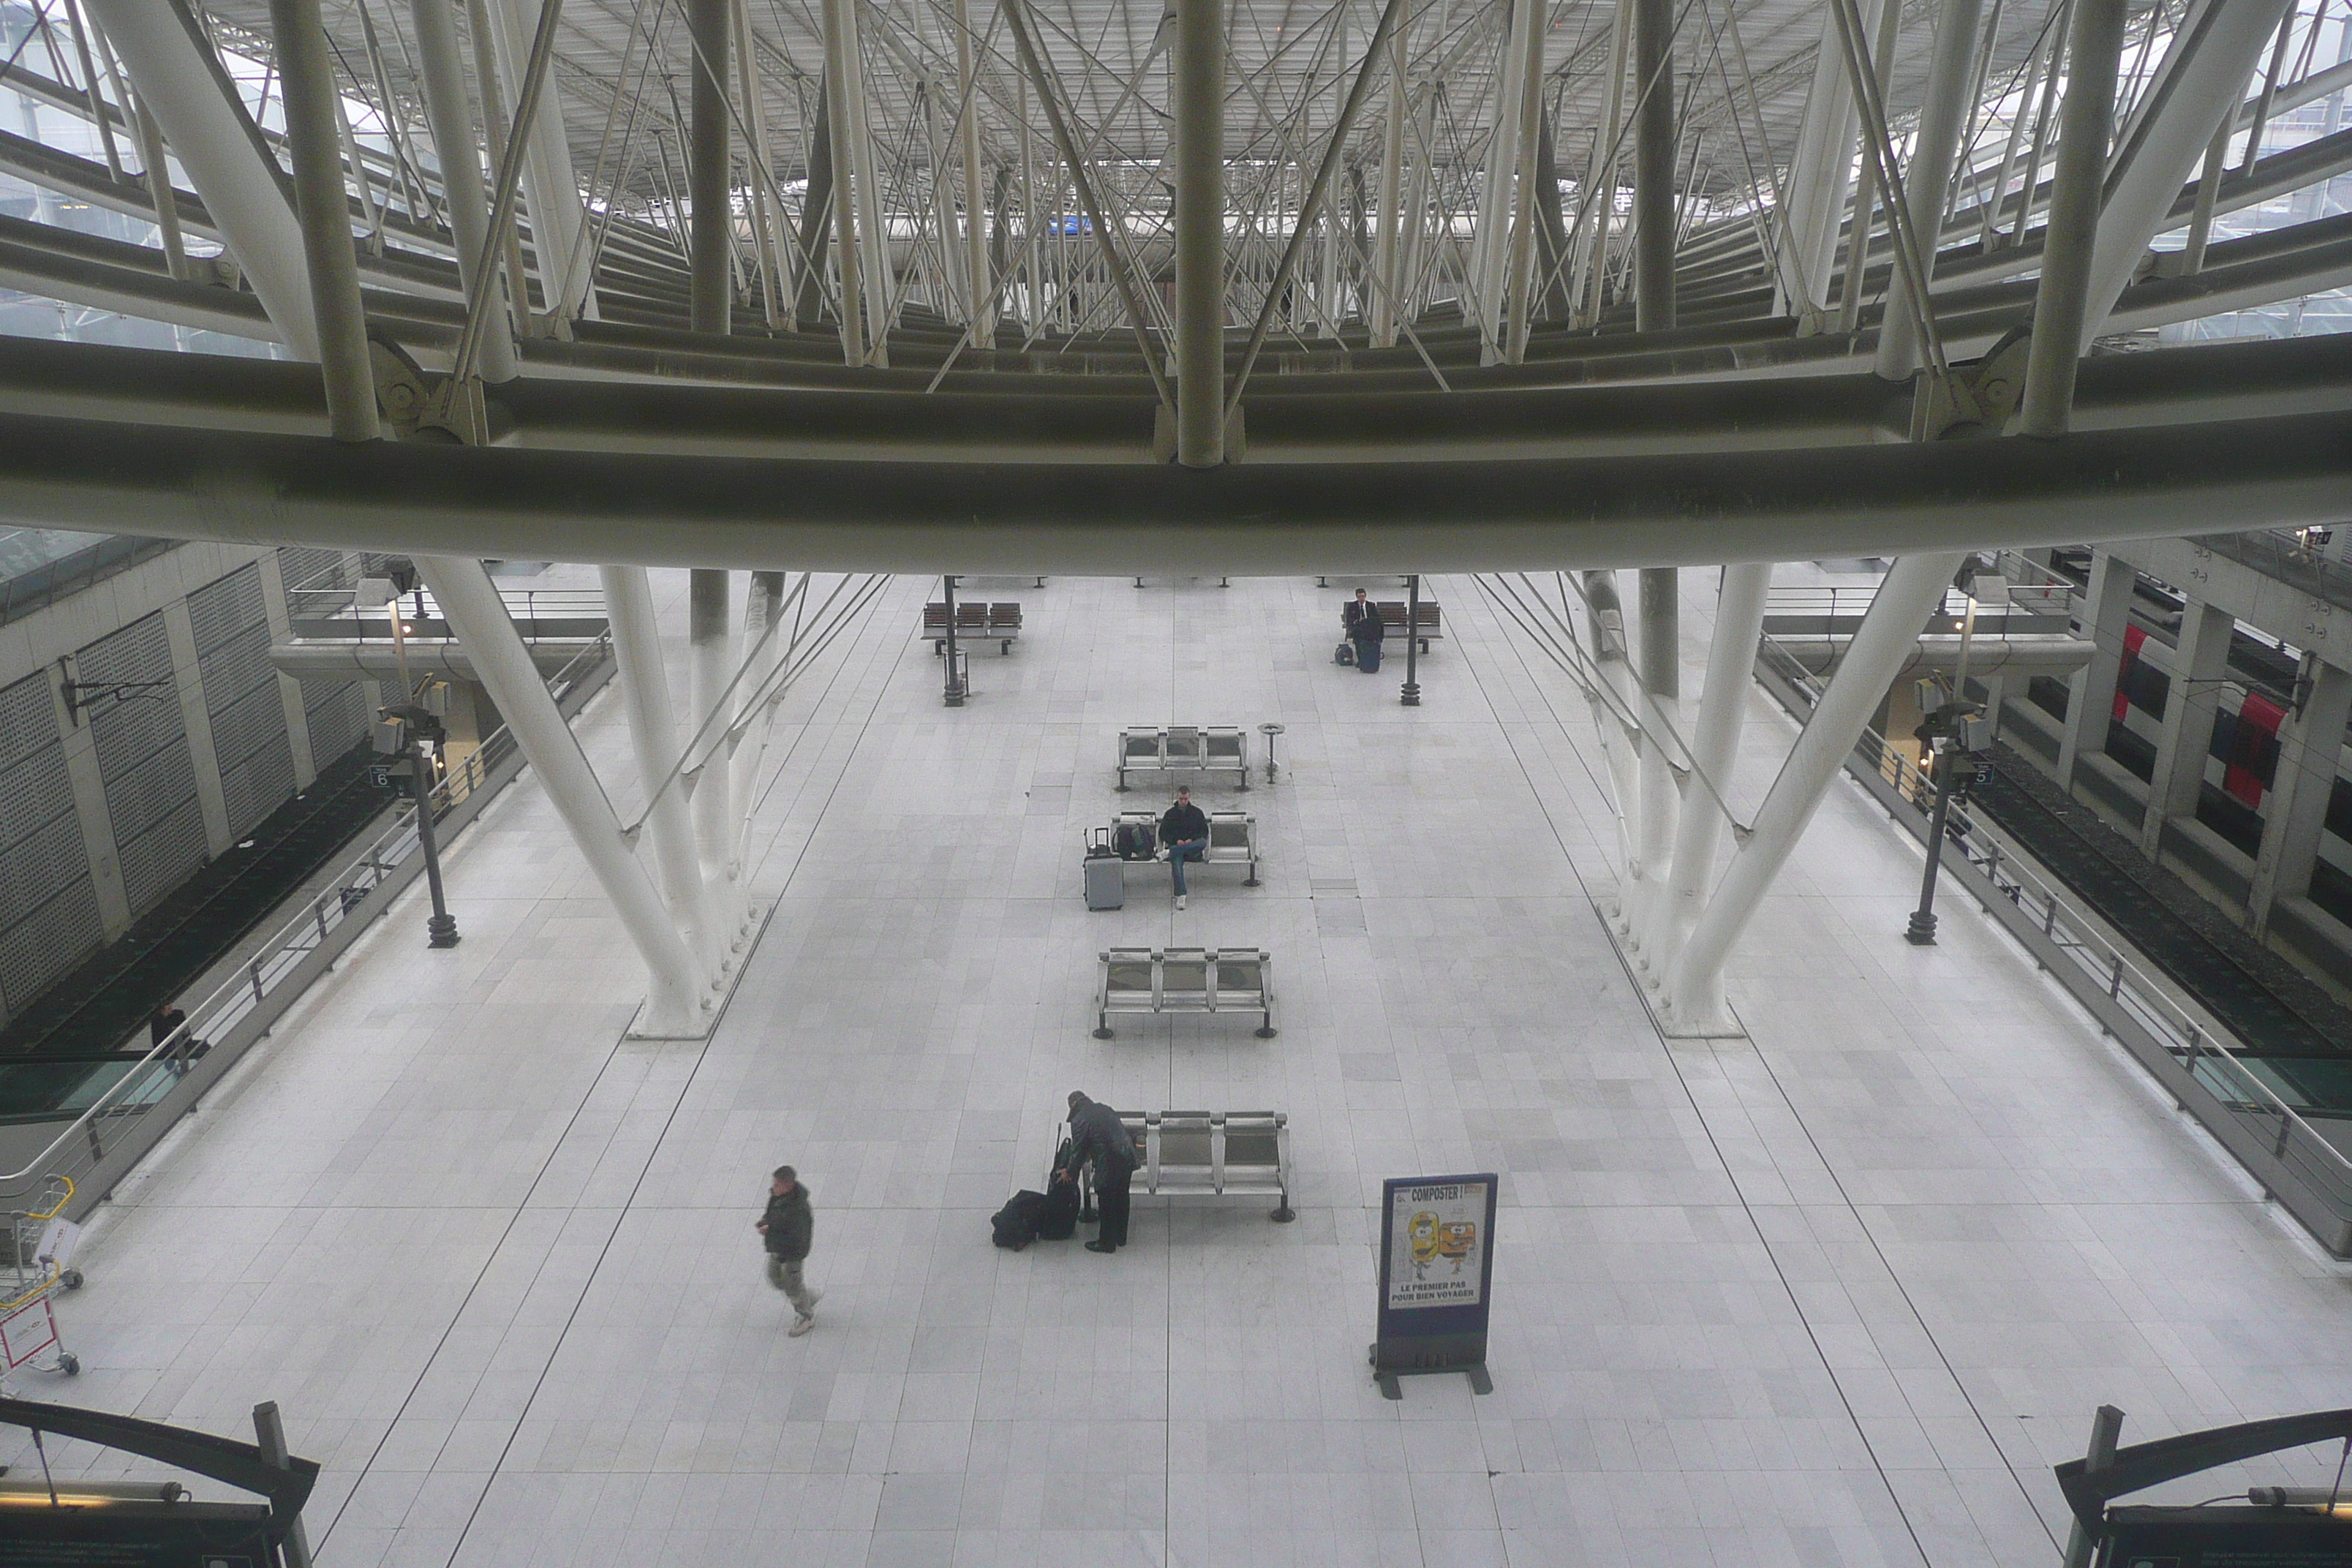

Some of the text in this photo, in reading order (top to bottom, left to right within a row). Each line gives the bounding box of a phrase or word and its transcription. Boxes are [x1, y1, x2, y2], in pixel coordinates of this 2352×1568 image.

[377, 773, 388, 785] 6
[1976, 770, 1986, 783] 5
[1411, 1186, 1459, 1202] COMPOSTER
[1460, 1185, 1463, 1199] !
[1412, 1282, 1449, 1292] PREMIER
[1436, 1289, 1474, 1299] VOYAGER
